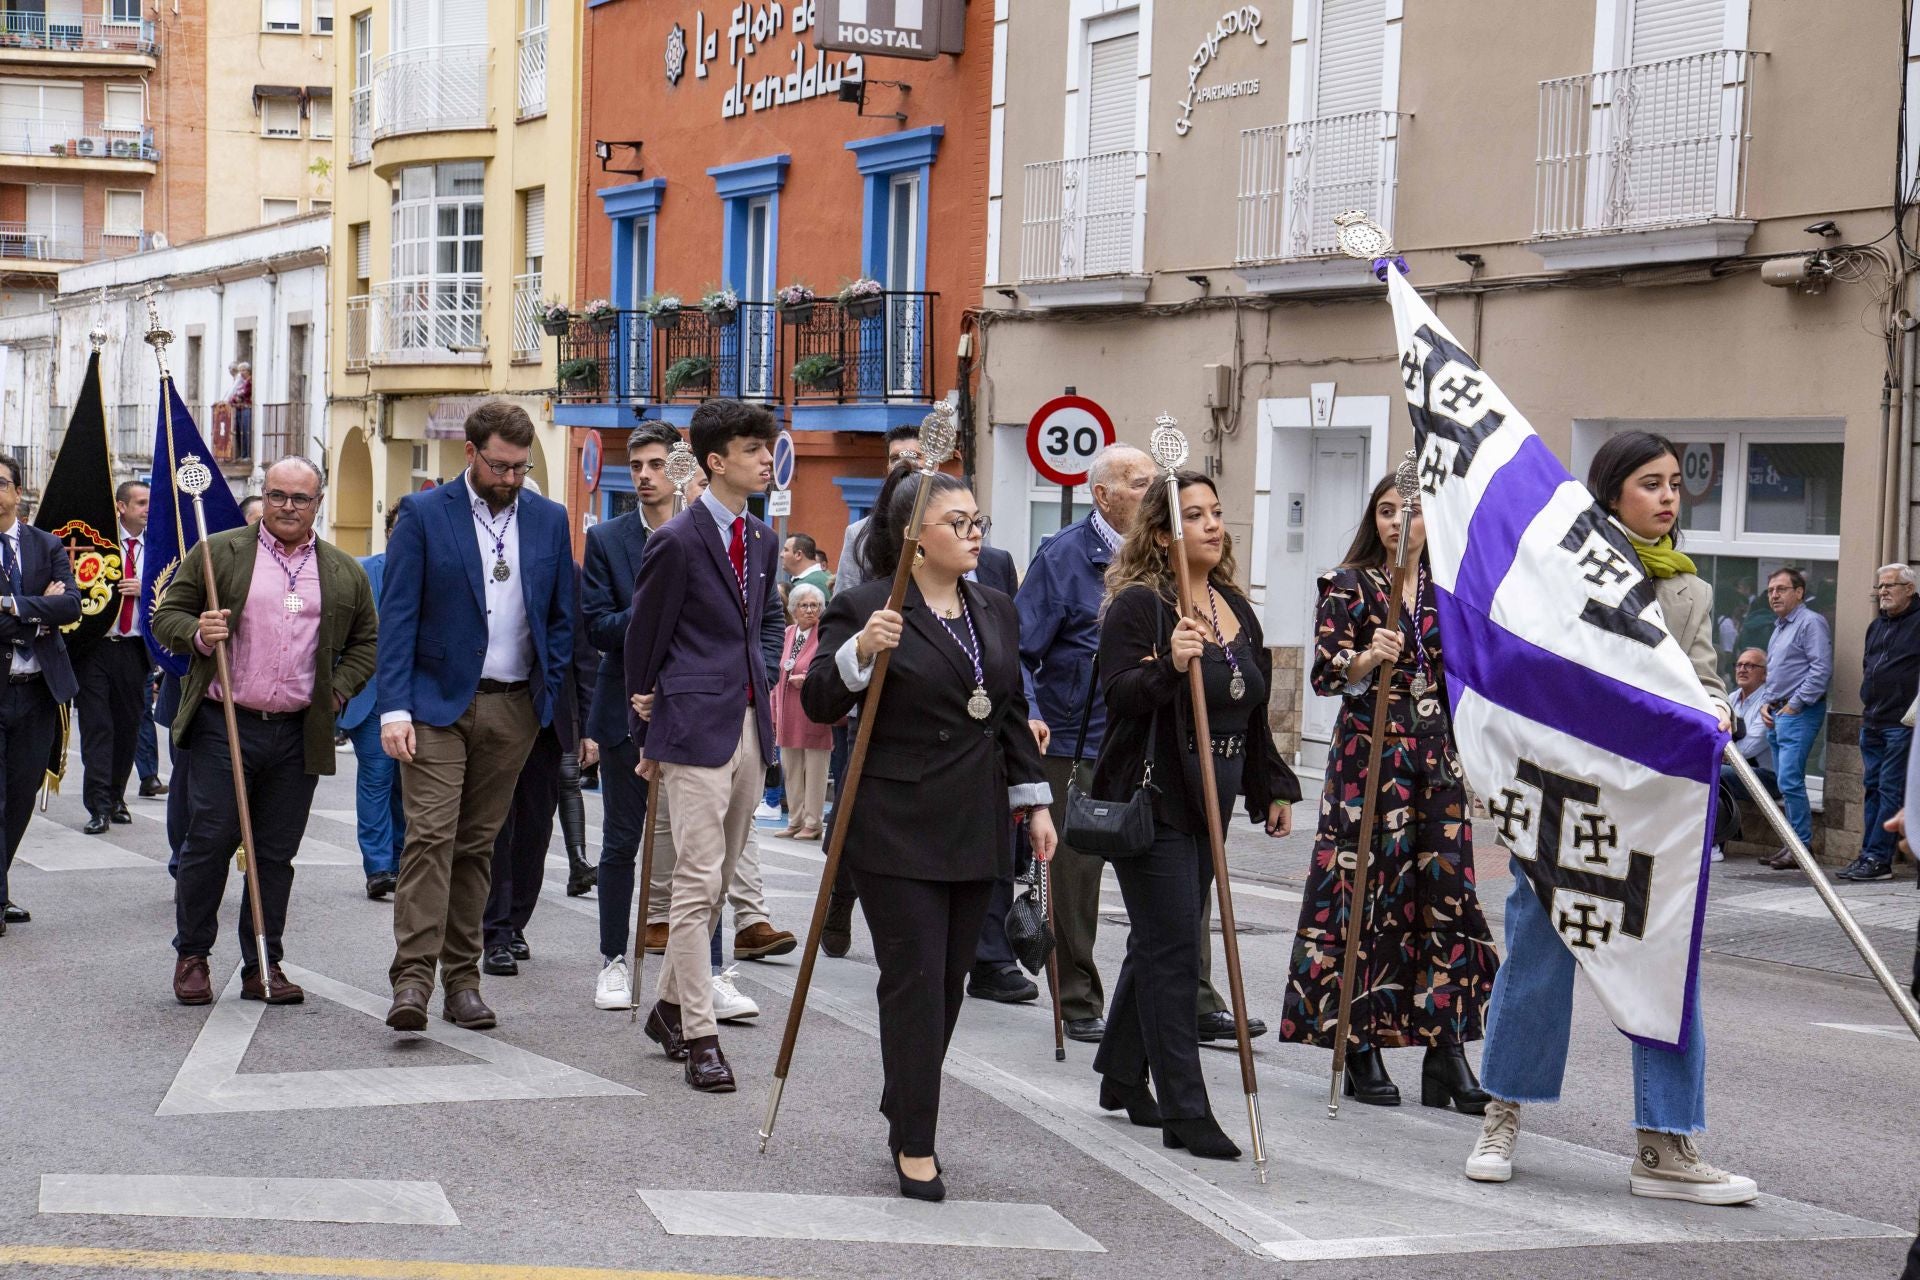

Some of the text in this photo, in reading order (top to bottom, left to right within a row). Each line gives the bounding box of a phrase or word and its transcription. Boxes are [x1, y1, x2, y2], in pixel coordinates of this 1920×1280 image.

[837, 25, 922, 49] HOSTAL
[1175, 4, 1267, 136] GLADIADOR
[1196, 79, 1260, 104] APARTAMENTOS
[1046, 426, 1098, 457] 30
